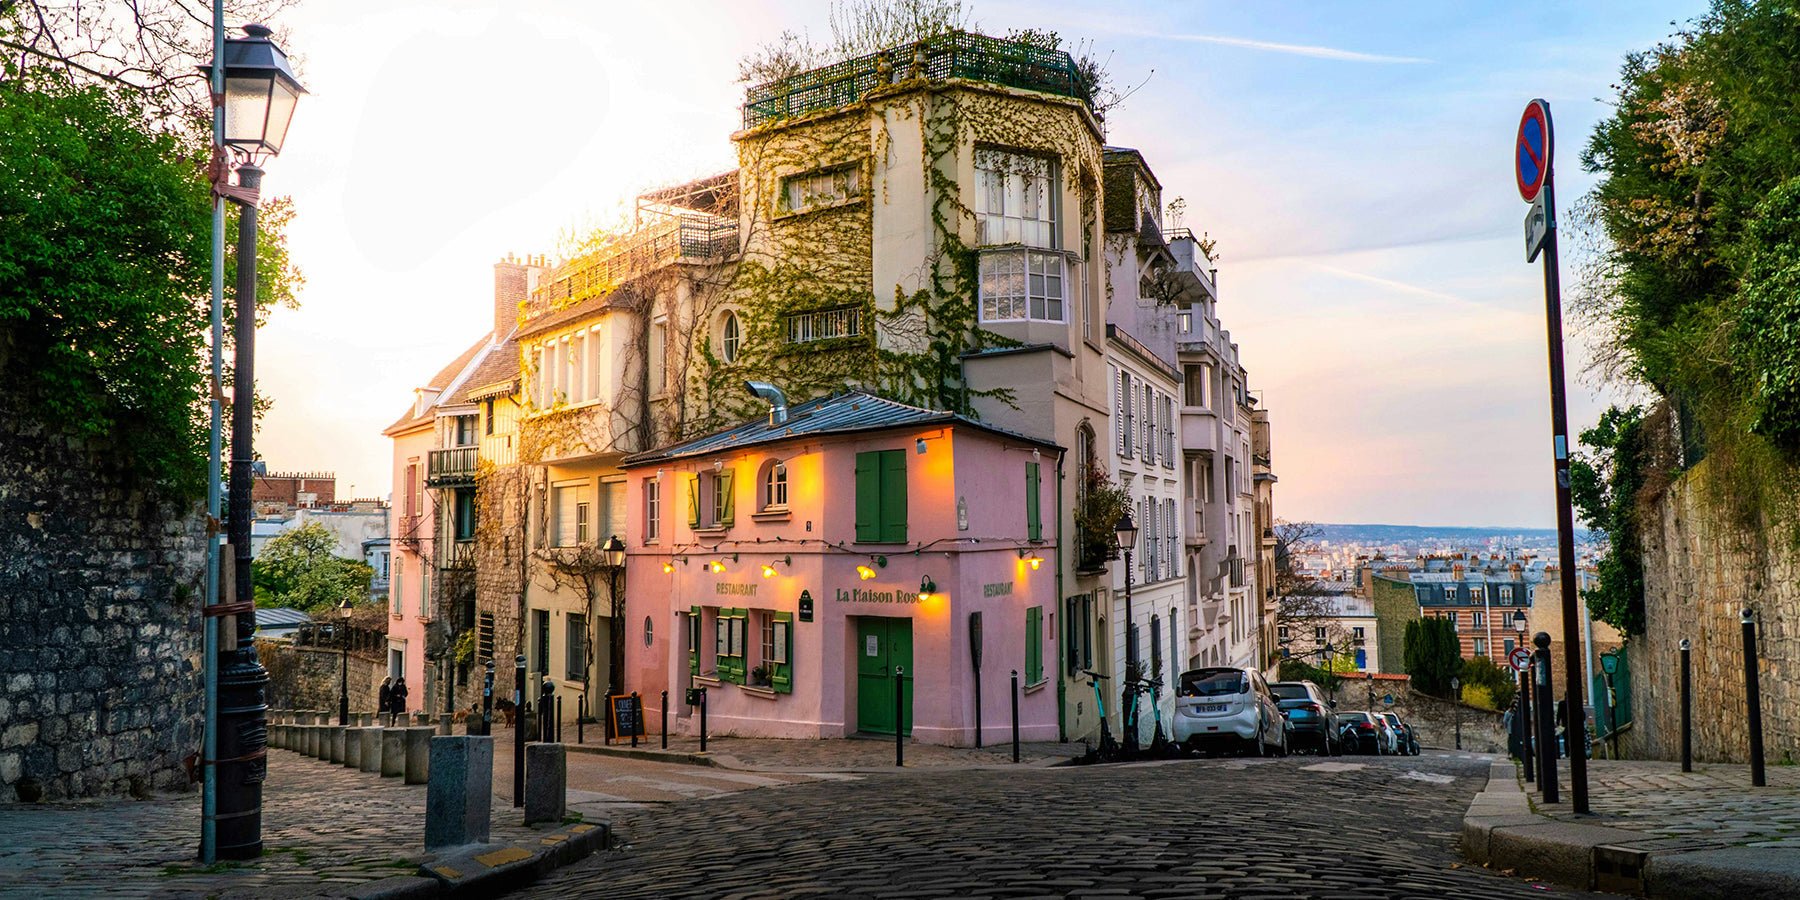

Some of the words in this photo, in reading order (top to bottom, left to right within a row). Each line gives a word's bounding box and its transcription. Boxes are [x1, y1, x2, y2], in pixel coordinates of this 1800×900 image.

[716, 582, 758, 597] RESTAURANT
[836, 588, 849, 602] La
[852, 588, 893, 603] Maison
[983, 581, 1013, 598] RESTAURANT
